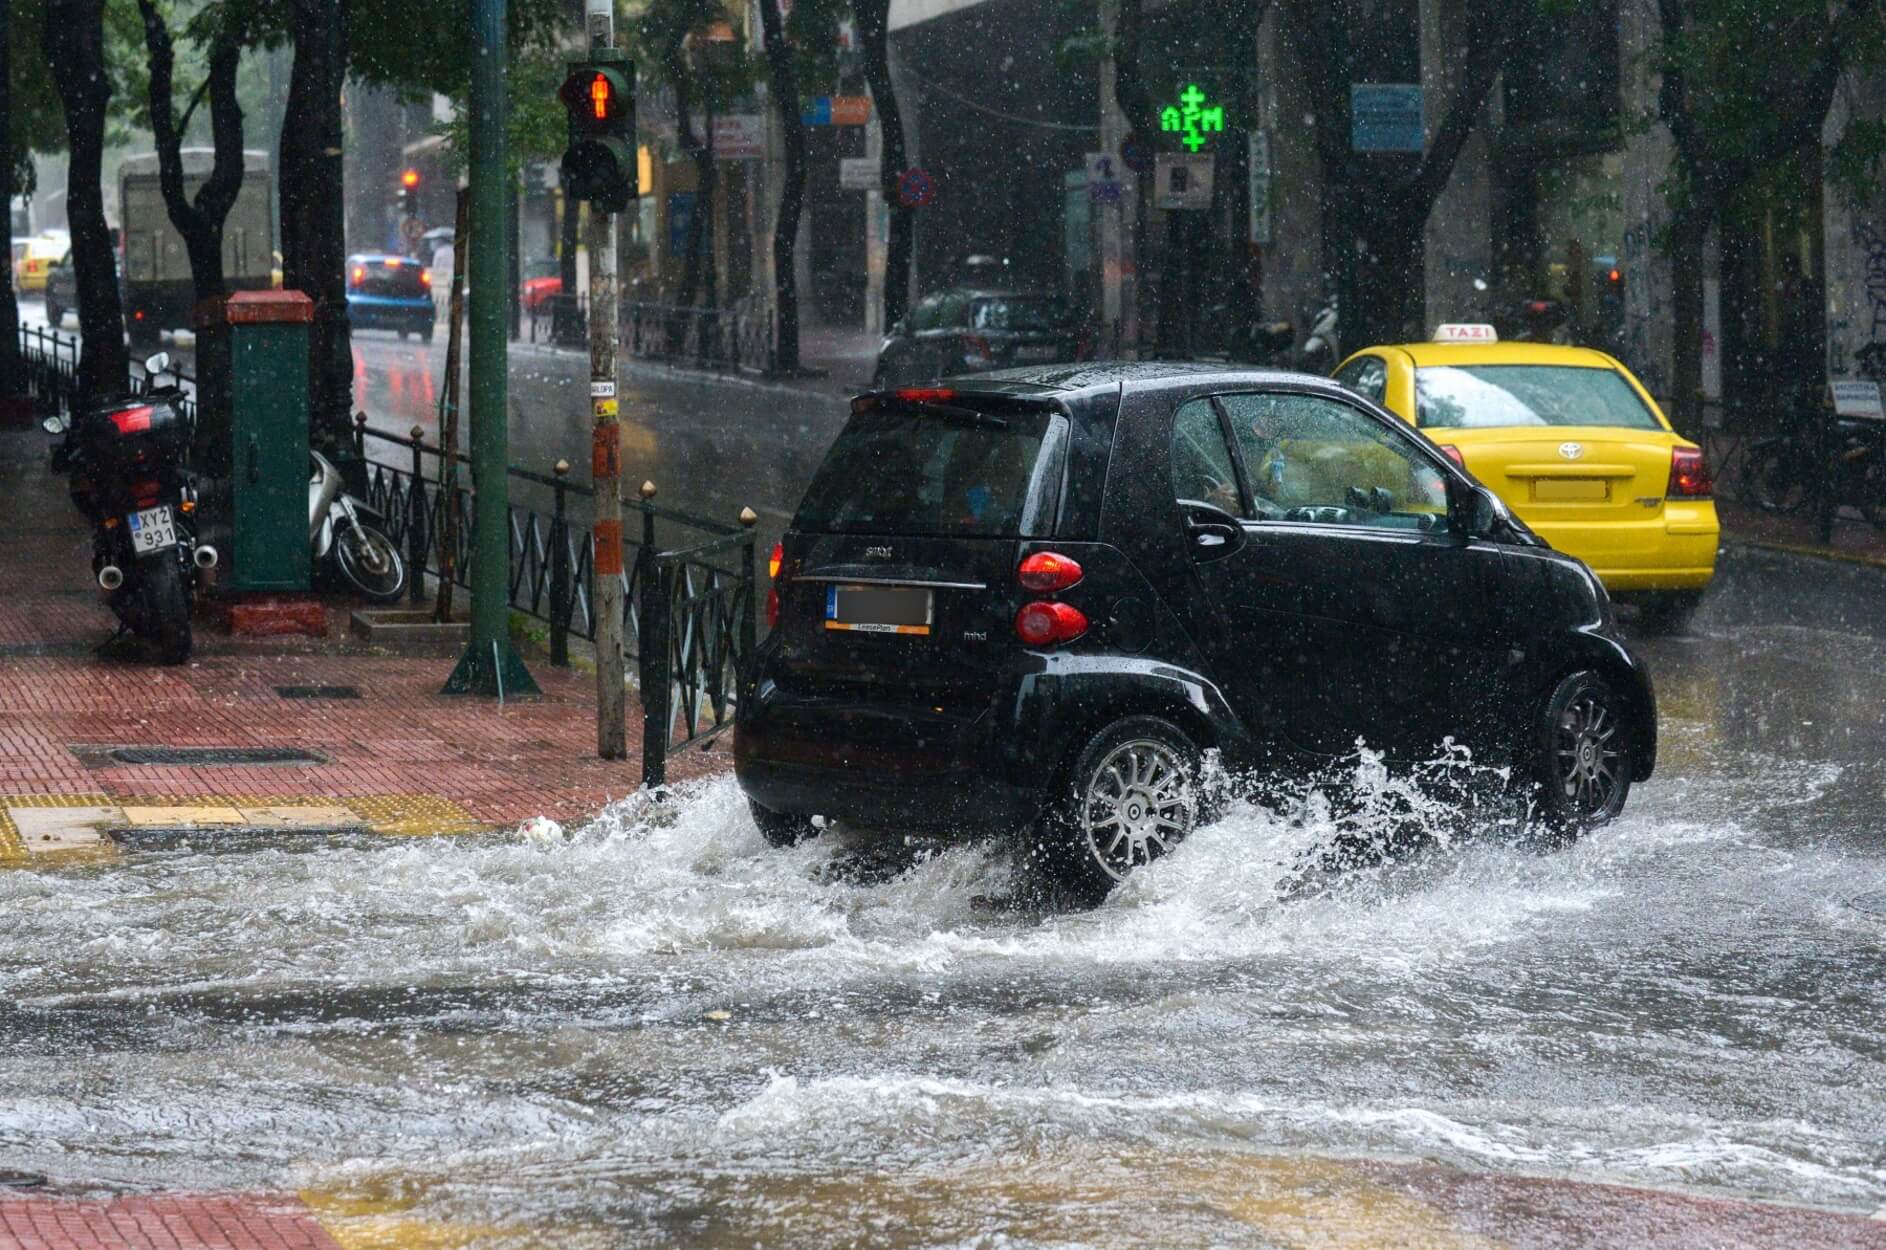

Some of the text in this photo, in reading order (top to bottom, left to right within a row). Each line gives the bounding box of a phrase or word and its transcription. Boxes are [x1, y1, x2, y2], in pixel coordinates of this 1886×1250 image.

[140, 510, 170, 528] XYZ
[144, 528, 173, 545] 931
[963, 632, 987, 641] mhd
